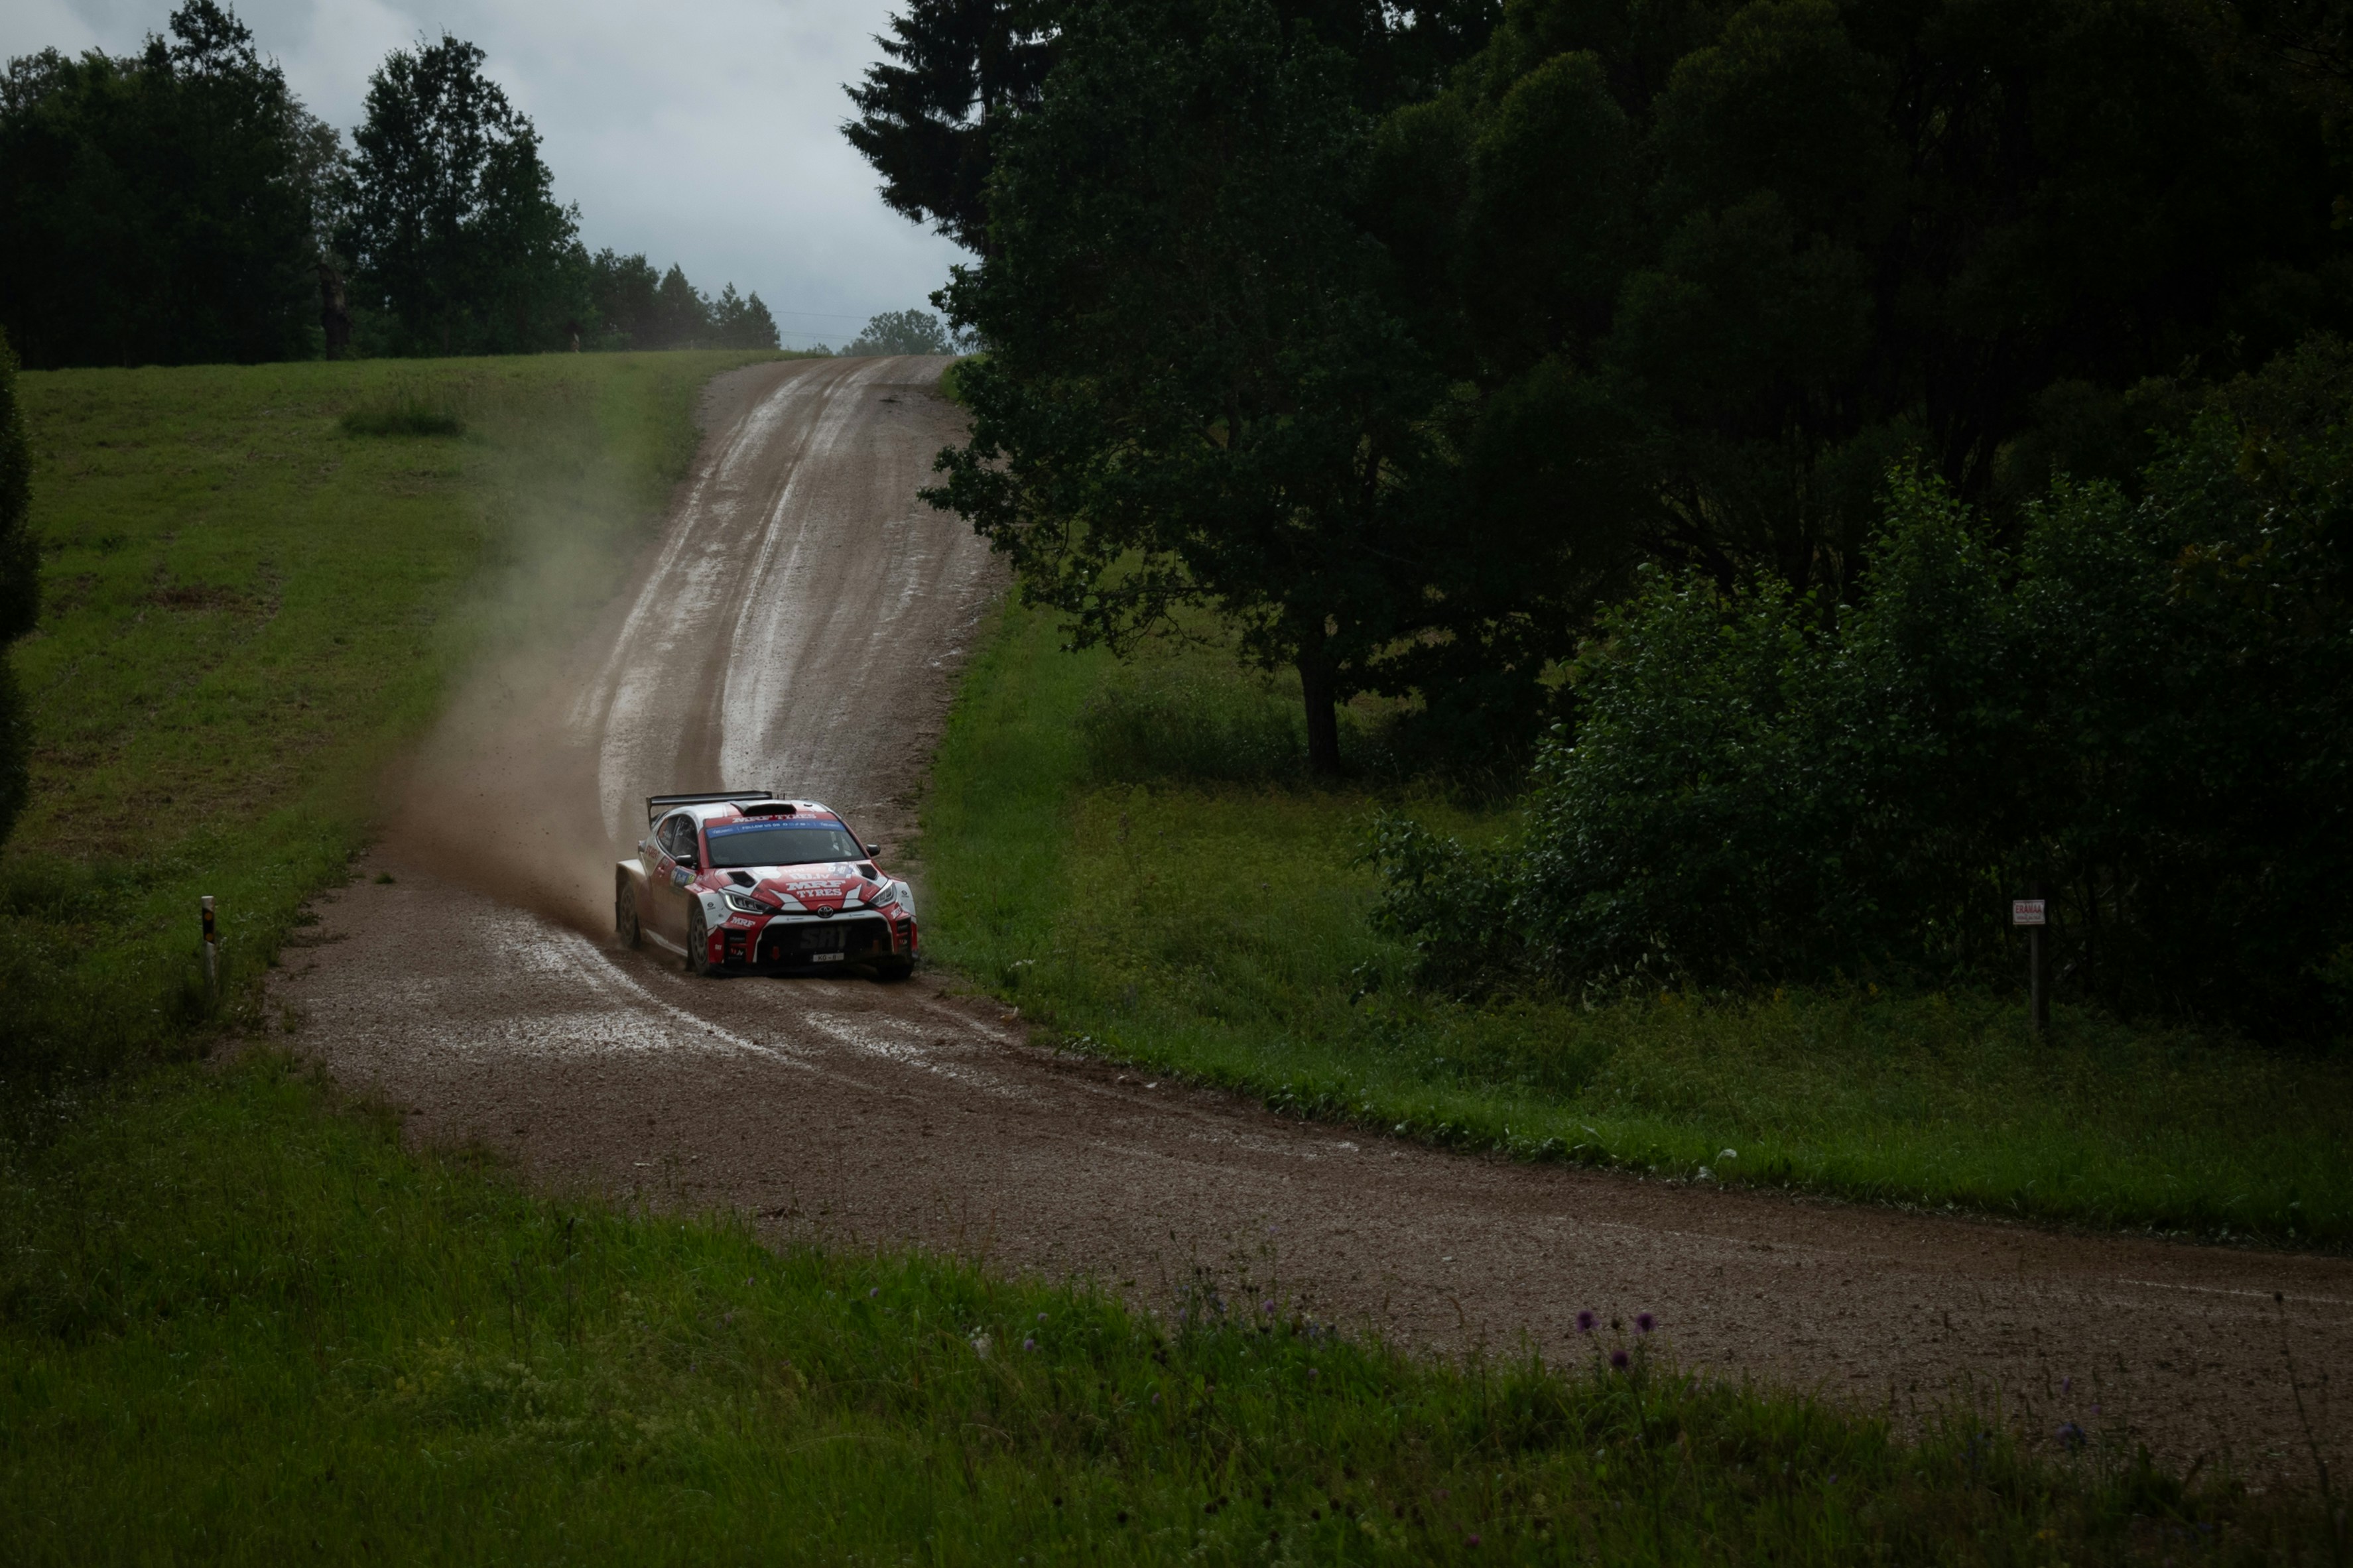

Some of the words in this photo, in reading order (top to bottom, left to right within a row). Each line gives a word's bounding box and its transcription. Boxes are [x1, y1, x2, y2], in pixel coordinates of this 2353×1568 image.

[786, 880, 846, 891] MRF
[796, 888, 843, 898] TYRES
[2015, 904, 2042, 914] ERAMAA
[730, 916, 756, 928] MRF
[800, 926, 852, 950] SRT
